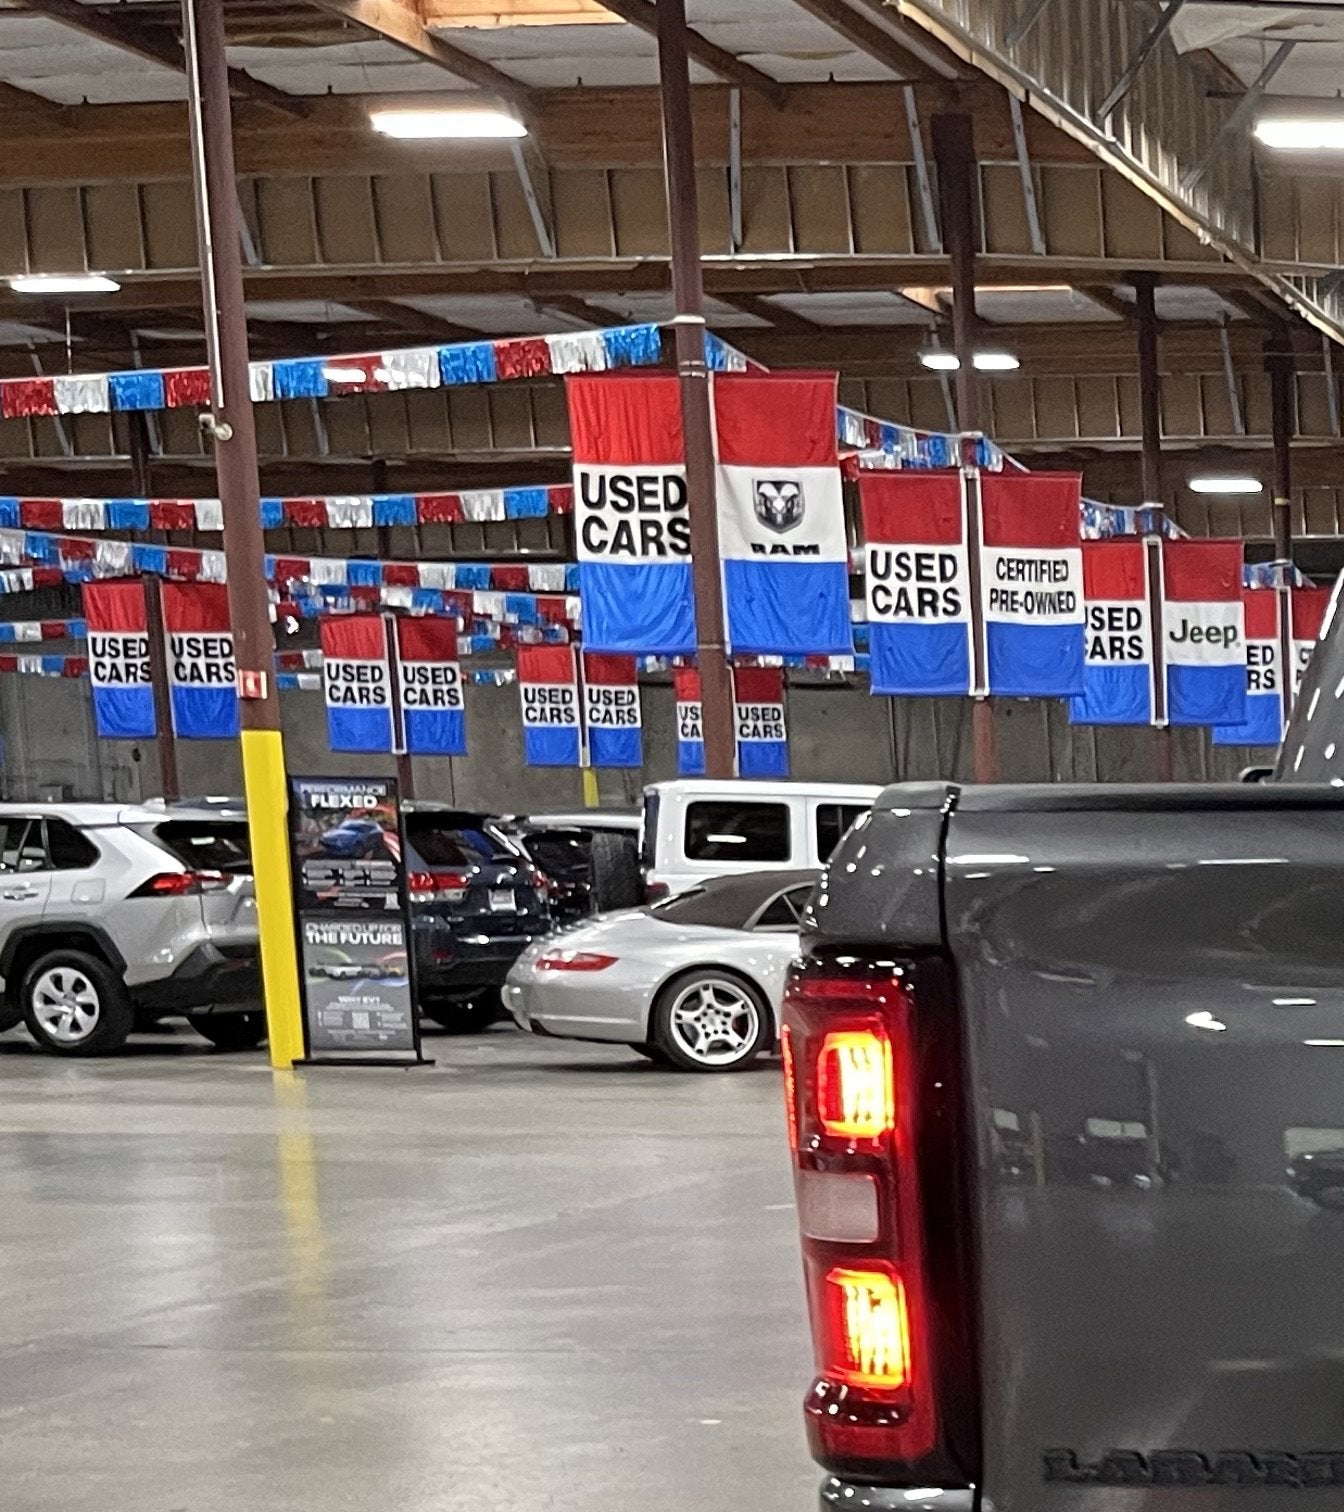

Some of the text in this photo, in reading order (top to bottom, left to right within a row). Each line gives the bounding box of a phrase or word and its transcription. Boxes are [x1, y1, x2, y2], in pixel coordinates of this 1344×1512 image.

[580, 472, 689, 513] USED
[581, 515, 691, 556] CARS
[750, 543, 820, 556] RAM
[870, 550, 958, 583] USED
[996, 557, 1069, 583] CERTIFIED
[871, 584, 962, 617] CARS
[989, 588, 1076, 615] PRE-OWNED
[1085, 606, 1142, 632] SED
[1169, 619, 1238, 649] Jeep
[91, 637, 149, 659] USED
[171, 637, 233, 659] USED
[1085, 635, 1144, 660] ARS
[1247, 645, 1275, 666] ED
[94, 661, 151, 683] CARS
[174, 661, 236, 683] CARS
[327, 663, 383, 683] USED
[403, 666, 457, 685] USED
[1247, 668, 1276, 690] RS
[328, 684, 386, 705] CARS
[403, 687, 460, 706] CARS
[523, 687, 573, 705] USED
[588, 688, 636, 706] USED
[525, 706, 575, 724] CARS
[588, 707, 638, 725] CARS
[680, 705, 699, 721] US
[738, 706, 781, 722] USED
[681, 722, 701, 737] CA
[739, 723, 783, 739] CARS
[311, 794, 378, 808] FLEXED
[306, 932, 402, 945] THE FUTURE
